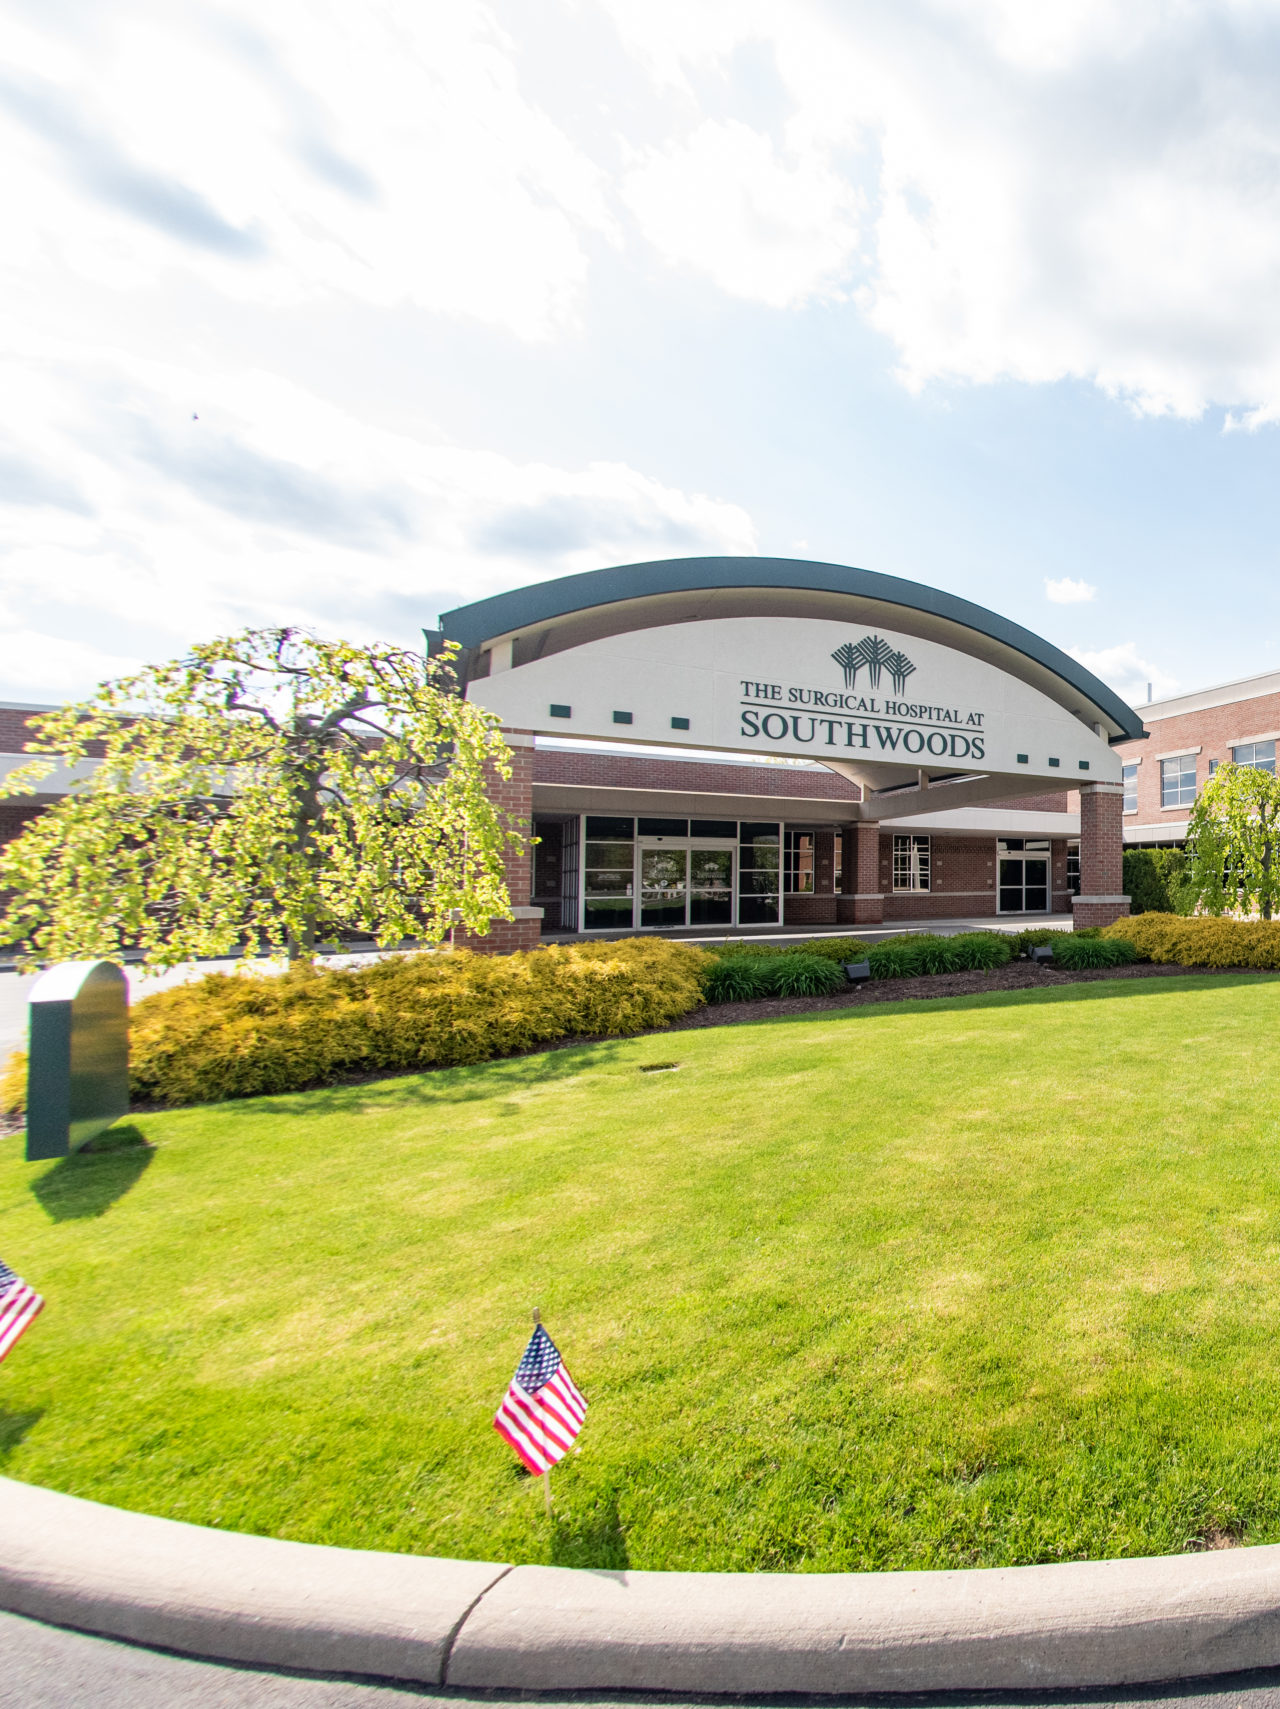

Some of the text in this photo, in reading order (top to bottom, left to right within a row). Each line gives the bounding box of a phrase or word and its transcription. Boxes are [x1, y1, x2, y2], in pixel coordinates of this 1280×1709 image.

[740, 681, 985, 727] THE SURGICAL HOSPITAL AT
[740, 710, 986, 760] SOUTHWOODS
